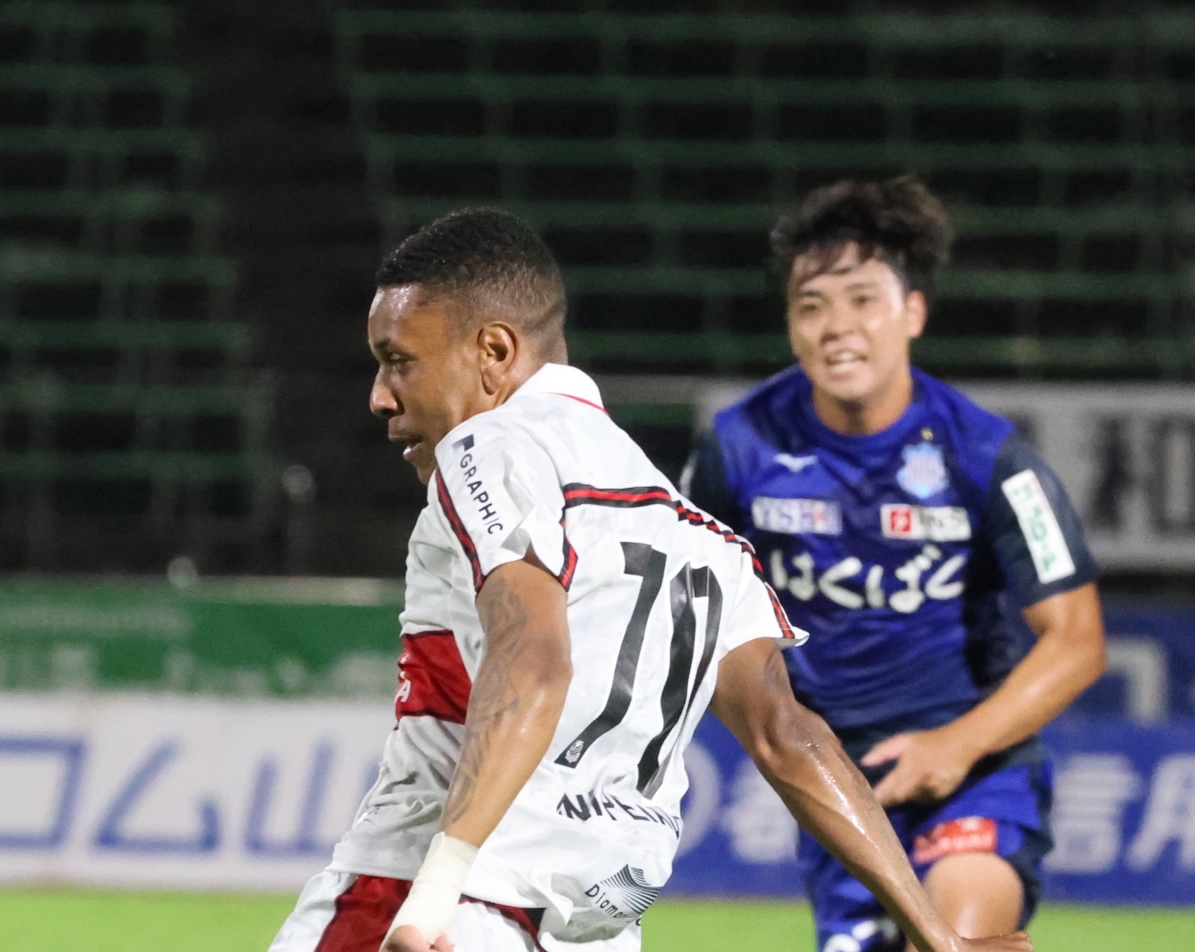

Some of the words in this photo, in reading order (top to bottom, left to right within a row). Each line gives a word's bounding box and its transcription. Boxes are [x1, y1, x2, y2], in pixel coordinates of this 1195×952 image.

[460, 453, 504, 535] GRAPHIC
[770, 545, 966, 613] はくばく
